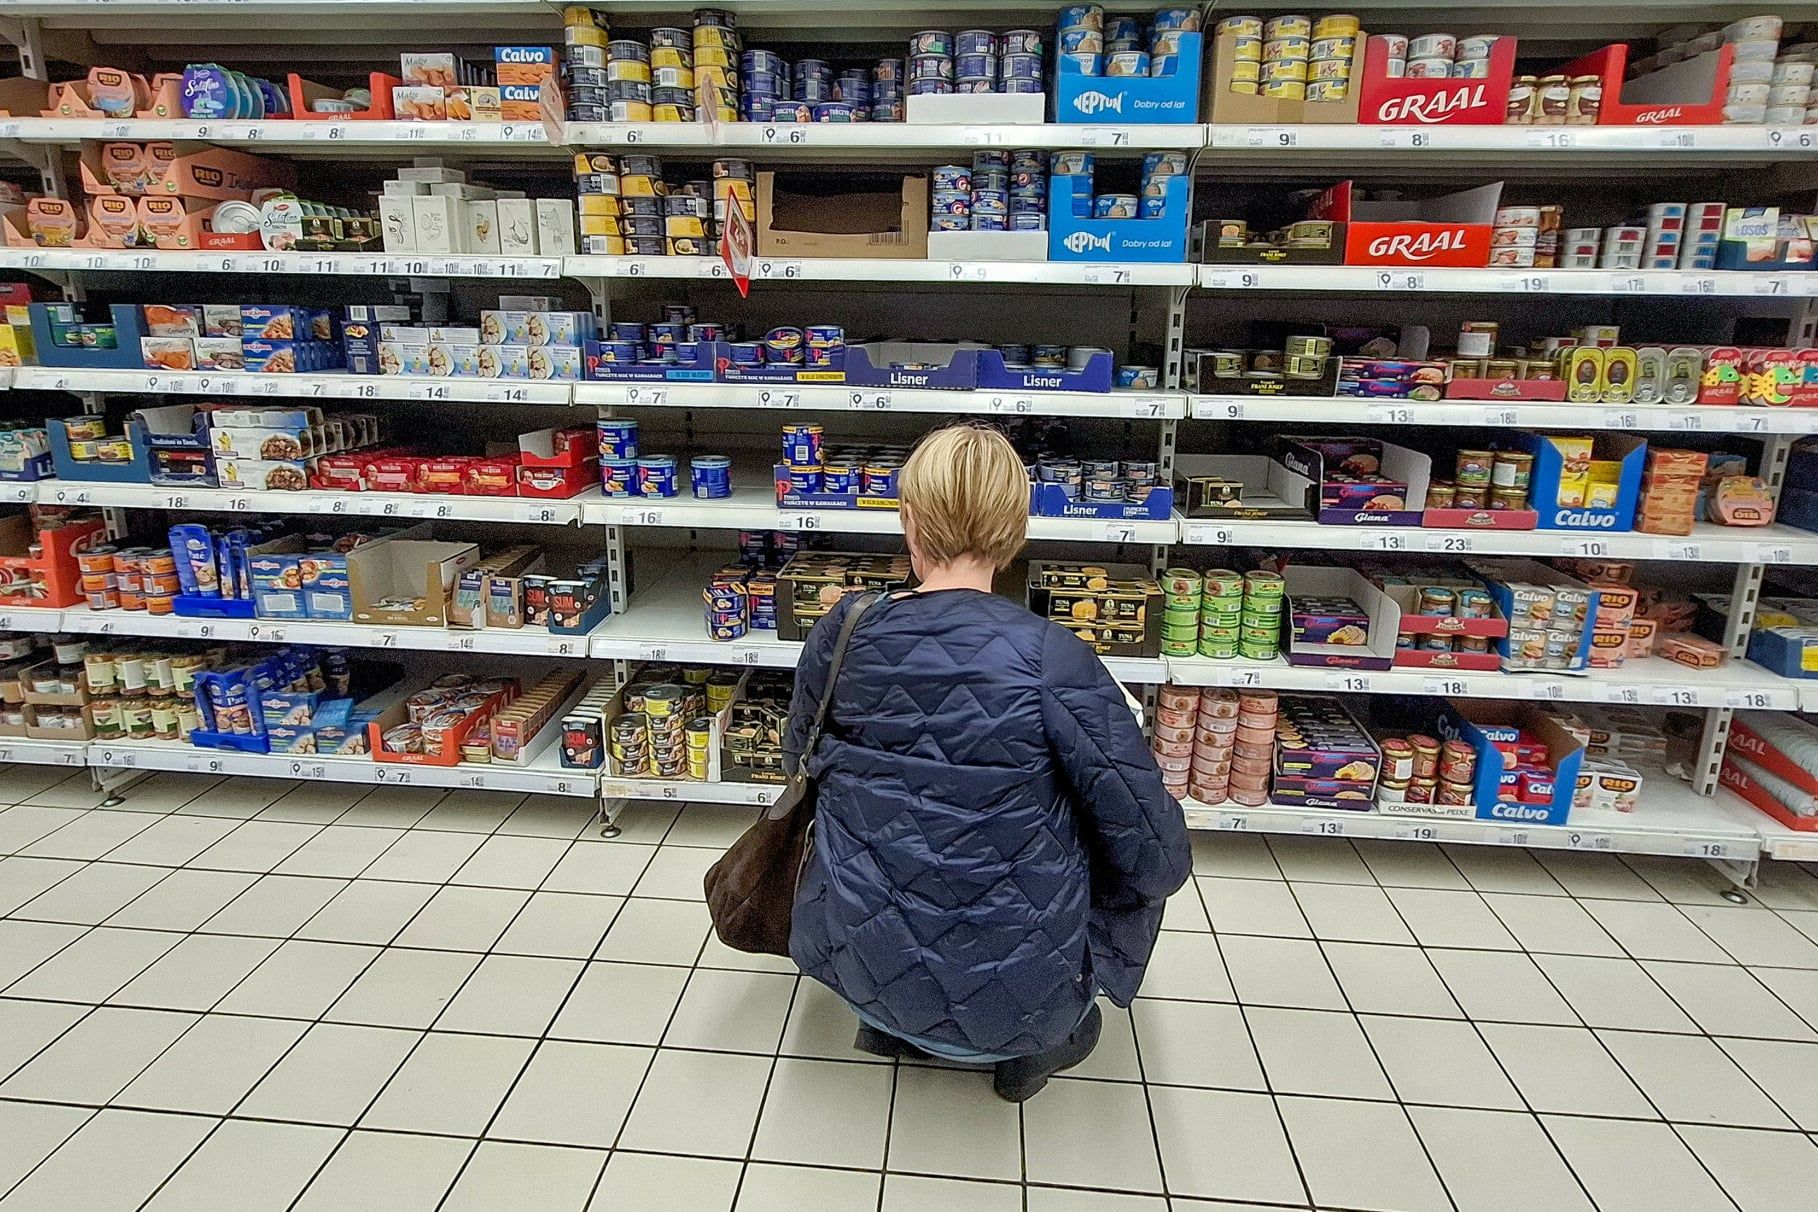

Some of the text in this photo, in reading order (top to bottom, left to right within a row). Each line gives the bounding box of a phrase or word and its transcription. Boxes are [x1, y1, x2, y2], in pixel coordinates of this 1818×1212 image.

[501, 48, 544, 62] Calvo
[100, 73, 120, 84] RIO
[506, 87, 540, 100] Calv
[1074, 90, 1123, 115] NEPTUN
[1134, 100, 1186, 110] Dobry od lat
[1378, 85, 1488, 123] GRAAL
[1636, 107, 1682, 123] GRAAL
[198, 127, 208, 138] 9
[248, 130, 258, 140] 8
[329, 128, 338, 138] 8
[627, 131, 636, 142] 6
[791, 132, 799, 142] 6
[1112, 134, 1122, 145] 7
[1280, 134, 1289, 145] 9
[1412, 134, 1422, 146] 8
[1800, 134, 1810, 146] 6
[194, 169, 222, 181] RIO
[40, 204, 61, 214] RIO
[103, 202, 124, 212] RIO
[148, 202, 170, 212] RIO
[208, 236, 236, 247] GRAAL
[1064, 231, 1111, 254] NEPTUN
[1122, 240, 1173, 250] Dobry od lat
[1368, 230, 1467, 261] GRAAL
[222, 260, 230, 270] 6
[263, 260, 279, 271] 10
[316, 261, 332, 272] 11
[371, 262, 386, 272] 11
[405, 262, 422, 273] 10
[499, 264, 515, 275] 11
[543, 265, 551, 276] 7
[630, 264, 638, 275] 6
[712, 266, 720, 276] 6
[786, 266, 794, 277] 6
[1114, 271, 1123, 282] 7
[1243, 275, 1252, 286] 9
[1407, 277, 1417, 288] 8
[1770, 282, 1780, 293] 7
[890, 373, 928, 386] Lisner
[1024, 374, 1062, 388] Lisner
[313, 385, 321, 395] 7
[358, 386, 374, 396] 18
[426, 388, 442, 398] 14
[504, 390, 521, 400] 14
[652, 392, 661, 404] 7
[784, 396, 793, 406] 7
[876, 397, 885, 408] 6
[1016, 401, 1025, 412] 6
[1150, 405, 1158, 416] 7
[1228, 406, 1237, 417] 9
[1388, 410, 1409, 422] 13
[18, 490, 26, 500] 9
[77, 494, 87, 502] 4
[168, 497, 182, 507] 18
[333, 502, 341, 512] 8
[384, 504, 392, 514] 8
[437, 506, 446, 516] 8
[1064, 505, 1098, 517] Lisner
[542, 510, 550, 522] 8
[639, 512, 656, 524] 16
[1554, 510, 1616, 528] Calvo
[797, 517, 814, 528] 16
[1120, 530, 1129, 542] 7
[1218, 532, 1226, 542] 9
[1380, 537, 1398, 548] 13
[1445, 539, 1465, 550] 23
[1581, 544, 1600, 555] 10
[1514, 591, 1548, 602] Calvo
[1556, 592, 1588, 602] Calv
[1600, 594, 1630, 604] RIO
[553, 596, 575, 612] SUM
[201, 626, 208, 636] 9
[384, 635, 391, 646] 7
[1550, 632, 1580, 642] Calv
[560, 644, 567, 654] 8
[1245, 673, 1253, 684] 7
[1345, 679, 1363, 690] 13
[1443, 682, 1461, 694] 18
[64, 754, 71, 764] 7
[210, 761, 217, 771] 9
[398, 773, 405, 782] 7
[558, 783, 566, 792] 8
[1602, 780, 1633, 788] RIO
[664, 788, 672, 798] 5
[758, 793, 765, 803] 6
[1388, 806, 1436, 814] CONSERVAS
[1492, 804, 1549, 822] Calvo
[1232, 818, 1241, 828] 7
[1319, 823, 1336, 833] 13
[1413, 828, 1431, 839] 19
